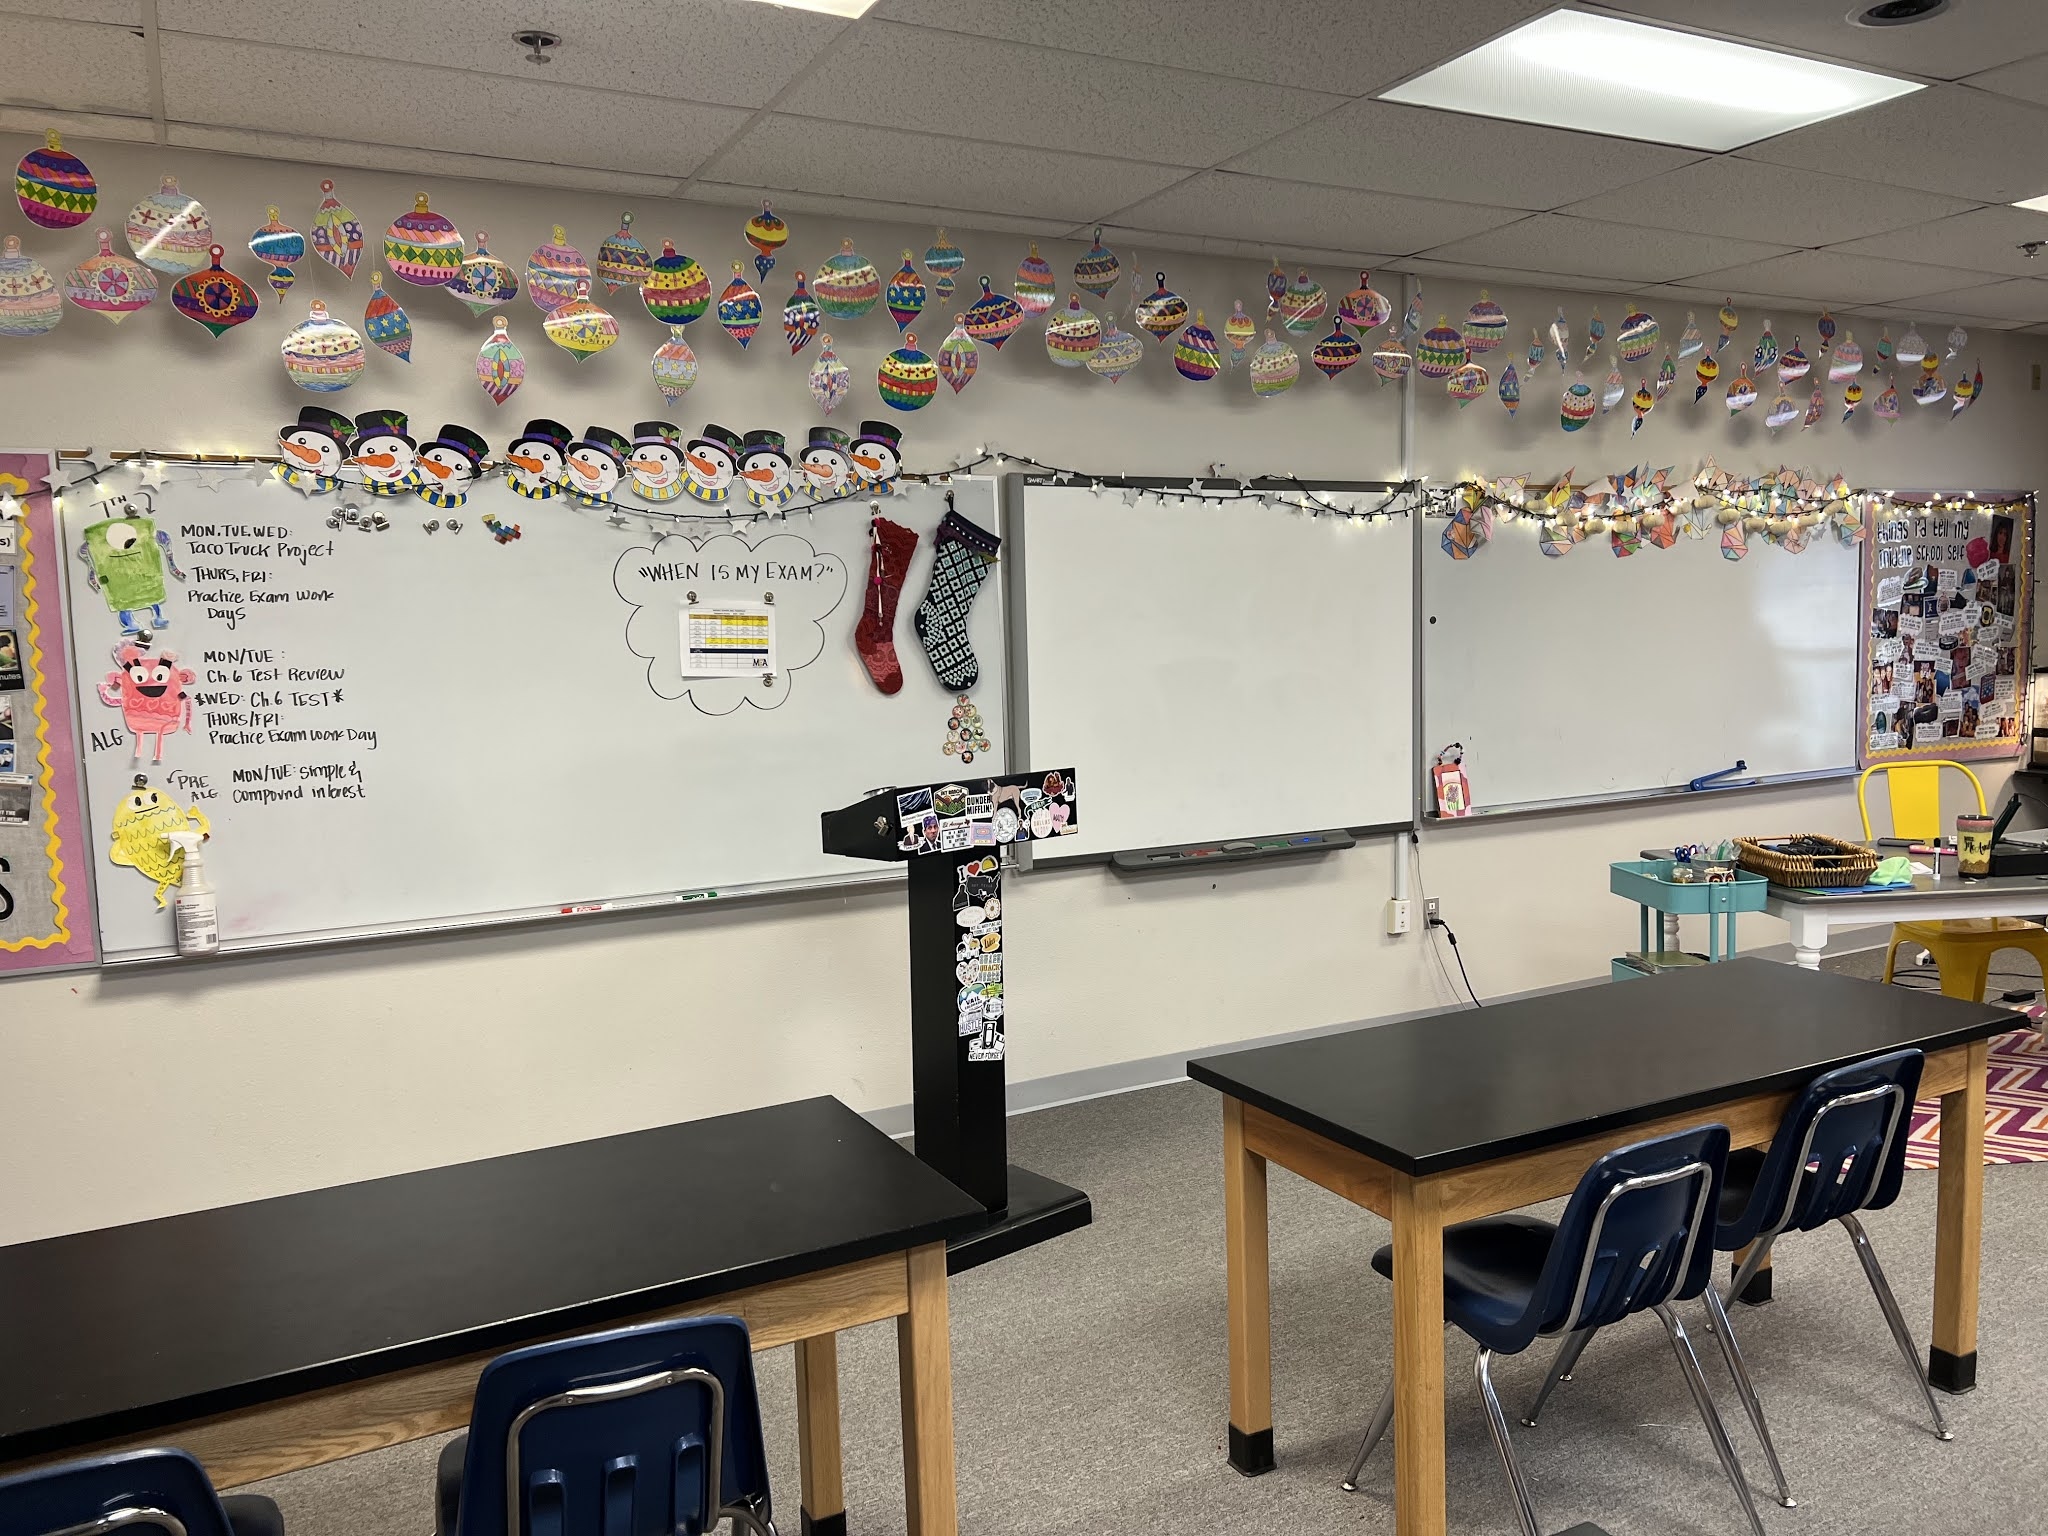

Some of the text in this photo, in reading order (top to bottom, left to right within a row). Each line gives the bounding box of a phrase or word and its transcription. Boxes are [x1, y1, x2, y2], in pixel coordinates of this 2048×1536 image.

[1954, 520, 1969, 540] my
[186, 540, 334, 566] Taco Truck Project
[1916, 545, 1943, 561] school
[1947, 544, 1965, 560] self
[711, 564, 730, 581] IS
[736, 564, 760, 583] MY
[187, 589, 245, 603] Practice
[249, 590, 290, 603] Exam
[207, 607, 247, 630] Days
[247, 668, 283, 682] Test
[288, 668, 345, 681] Review
[91, 728, 123, 752] ALG
[209, 730, 266, 744] Practice
[268, 730, 307, 743] Exam
[346, 728, 377, 750] Day
[177, 775, 218, 802] PRE ALG
[966, 795, 991, 806] DUNDER
[965, 995, 980, 1006] VAIL
